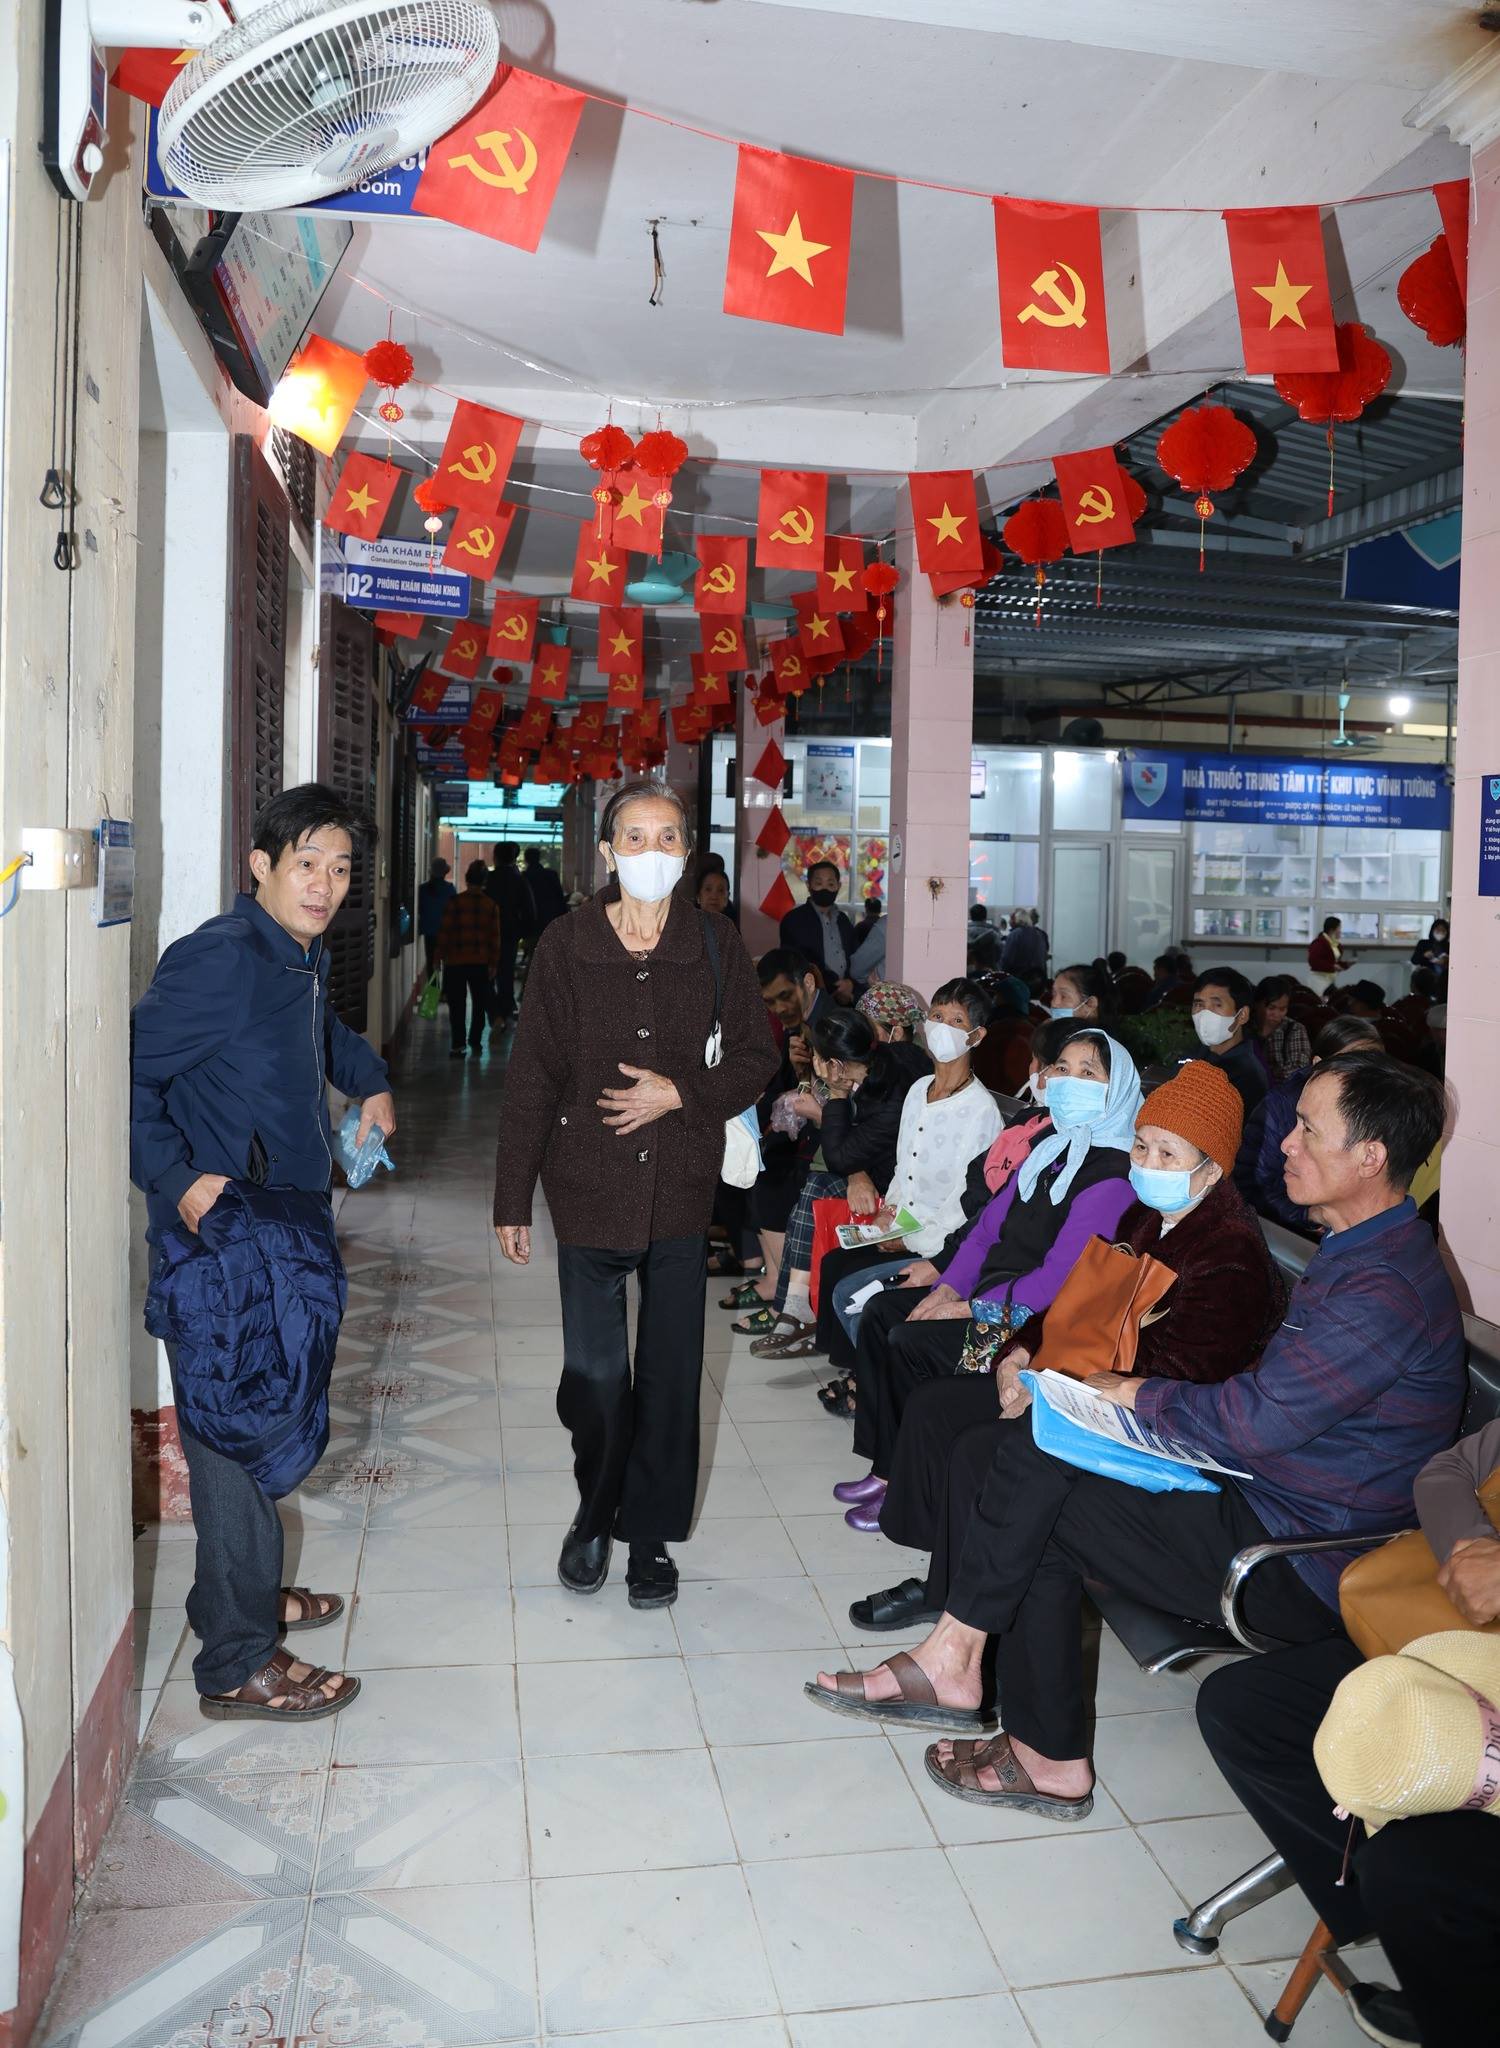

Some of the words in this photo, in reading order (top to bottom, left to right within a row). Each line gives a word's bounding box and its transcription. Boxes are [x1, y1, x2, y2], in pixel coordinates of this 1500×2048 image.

[360, 543, 389, 554] KHOA
[392, 546, 422, 557] KHÁM
[370, 555, 407, 565] Consultation
[347, 572, 374, 598] 02
[400, 579, 421, 593] KHÁM
[421, 582, 442, 597] NGOẠI
[442, 584, 461, 597] KHOA
[375, 592, 396, 601] External
[417, 597, 447, 607] Examination
[446, 600, 461, 608] Room
[1182, 766, 1205, 788] NHÀ
[1207, 765, 1243, 790] THUỐC
[1244, 771, 1280, 792] TRUNG
[1281, 770, 1305, 793] TÂM
[1306, 774, 1315, 793] Y
[1316, 770, 1330, 794] TẾ
[1330, 776, 1353, 794] KHU
[1354, 775, 1375, 799] VỰC
[1376, 774, 1401, 797] VĨNH
[1465, 1773, 1498, 1808] Dior
